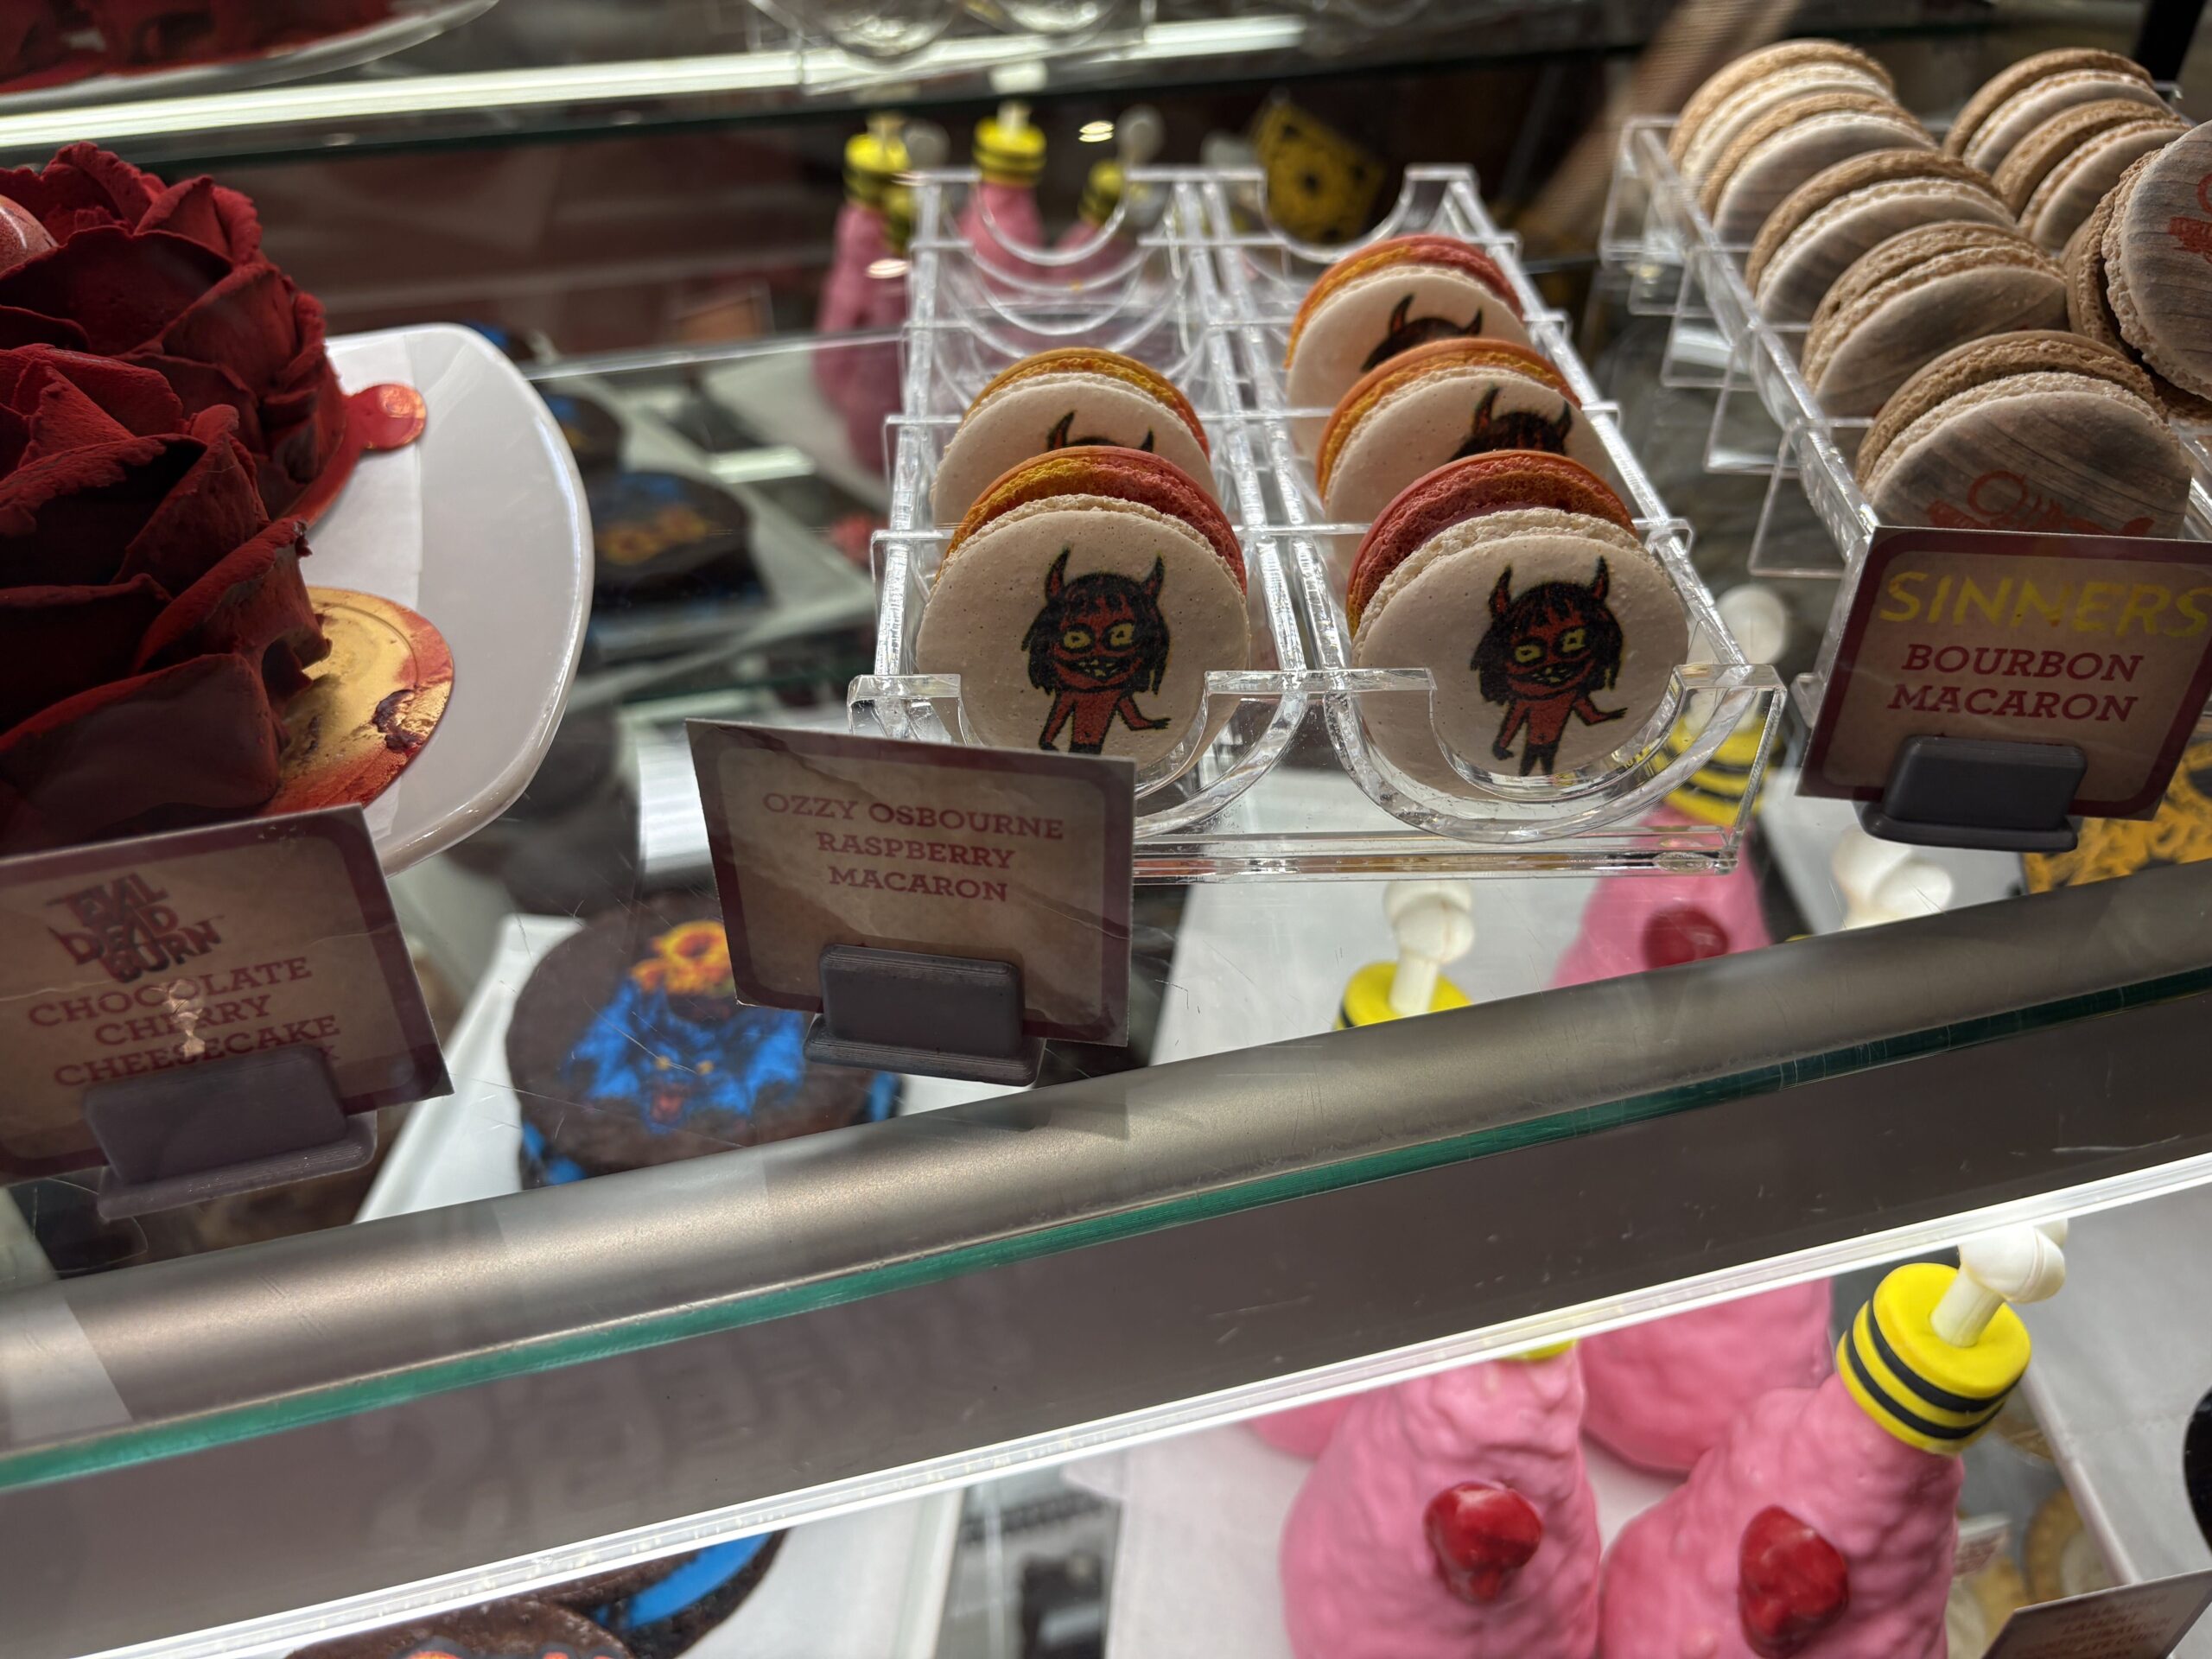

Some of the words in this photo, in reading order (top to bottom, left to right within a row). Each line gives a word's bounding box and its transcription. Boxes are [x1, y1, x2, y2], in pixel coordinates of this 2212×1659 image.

[1878, 571, 2212, 637] SINNERS
[1902, 644, 2144, 682] BOURBON
[1887, 683, 2138, 721] MACARON
[763, 792, 859, 820] OZZY
[868, 803, 1064, 840] OSBOURNE
[816, 831, 1015, 869] RASPBERRY
[44, 873, 168, 927] EVIL
[829, 866, 1008, 902] MACARON
[48, 905, 179, 965] DEAD
[99, 915, 226, 983] BURN
[29, 957, 313, 1027] CHOCOLATE
